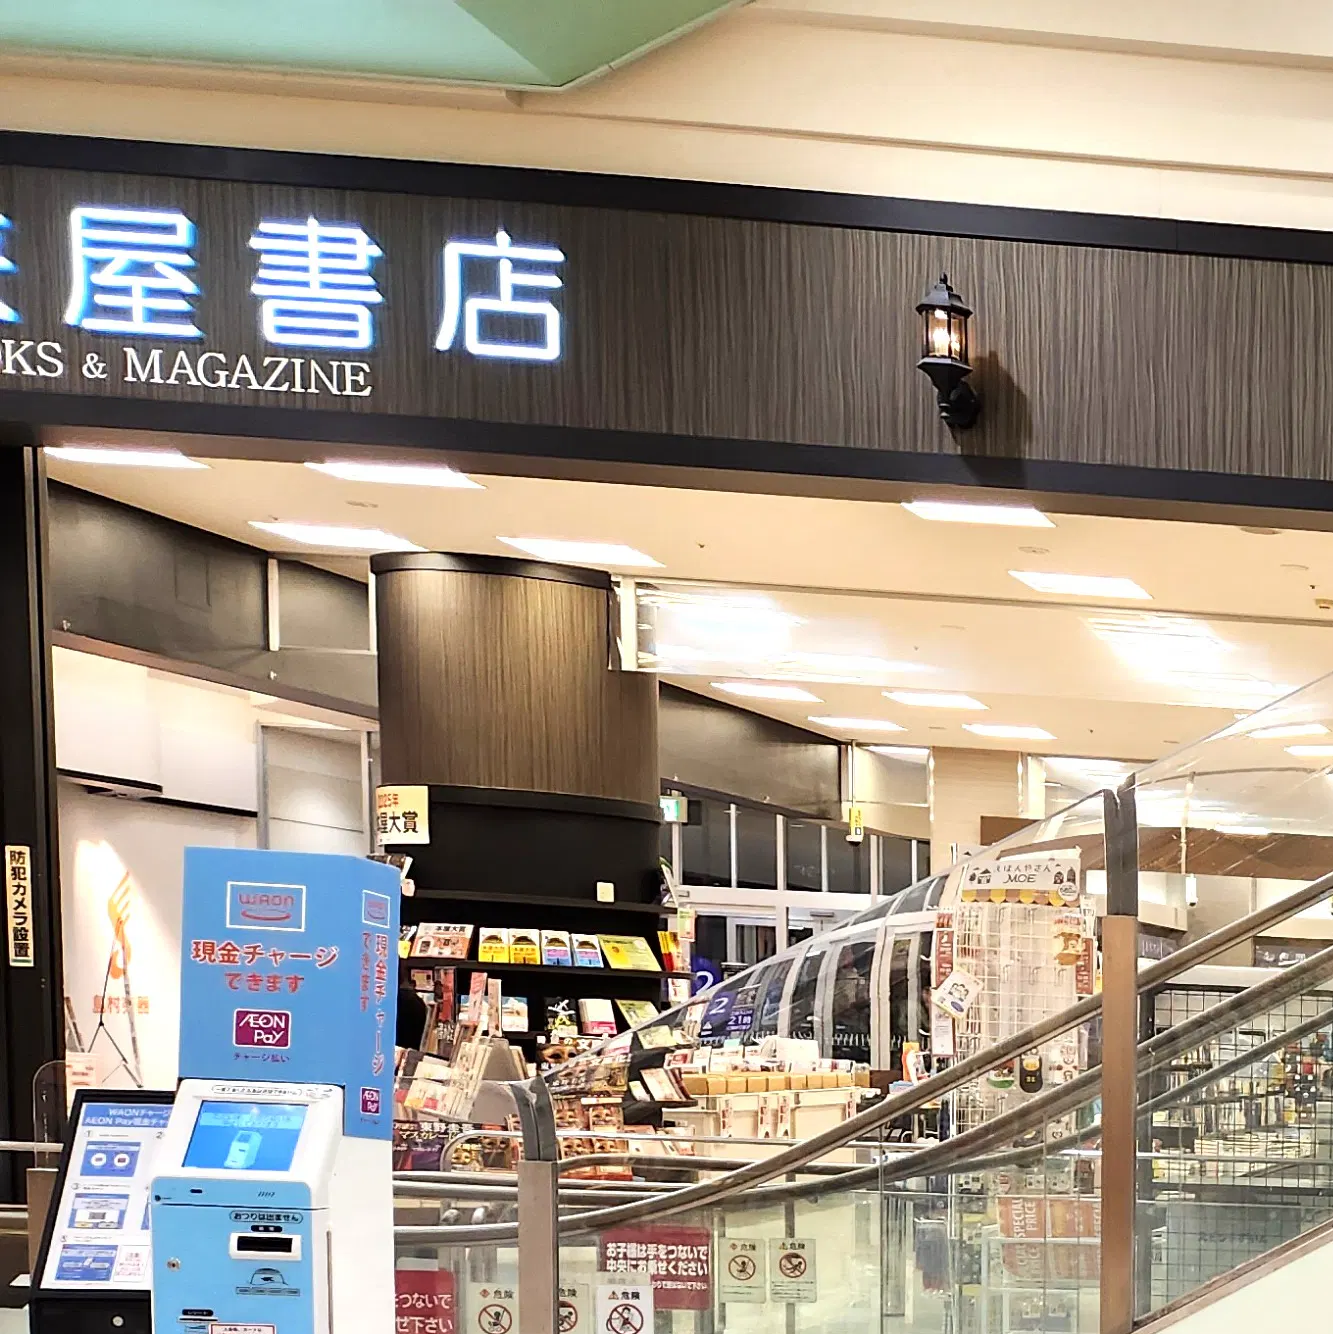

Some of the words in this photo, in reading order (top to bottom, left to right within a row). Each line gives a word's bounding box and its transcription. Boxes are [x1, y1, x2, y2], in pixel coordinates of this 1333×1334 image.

[0, 206, 567, 362] 屋書店
[0, 339, 64, 378] KS
[82, 352, 108, 380] &
[124, 346, 373, 397] MAGAZINE
[1002, 873, 1037, 884] MOE
[9, 850, 30, 958] 防犯カメラ設置
[238, 892, 295, 908] WAON
[190, 940, 340, 969] 現金チャージ
[224, 971, 305, 993] できます
[373, 933, 389, 1077] 現金チャージ
[233, 1211, 300, 1222] おつりは出ません
[493, 1288, 514, 1300] 危険
[621, 1291, 641, 1301] 危険
